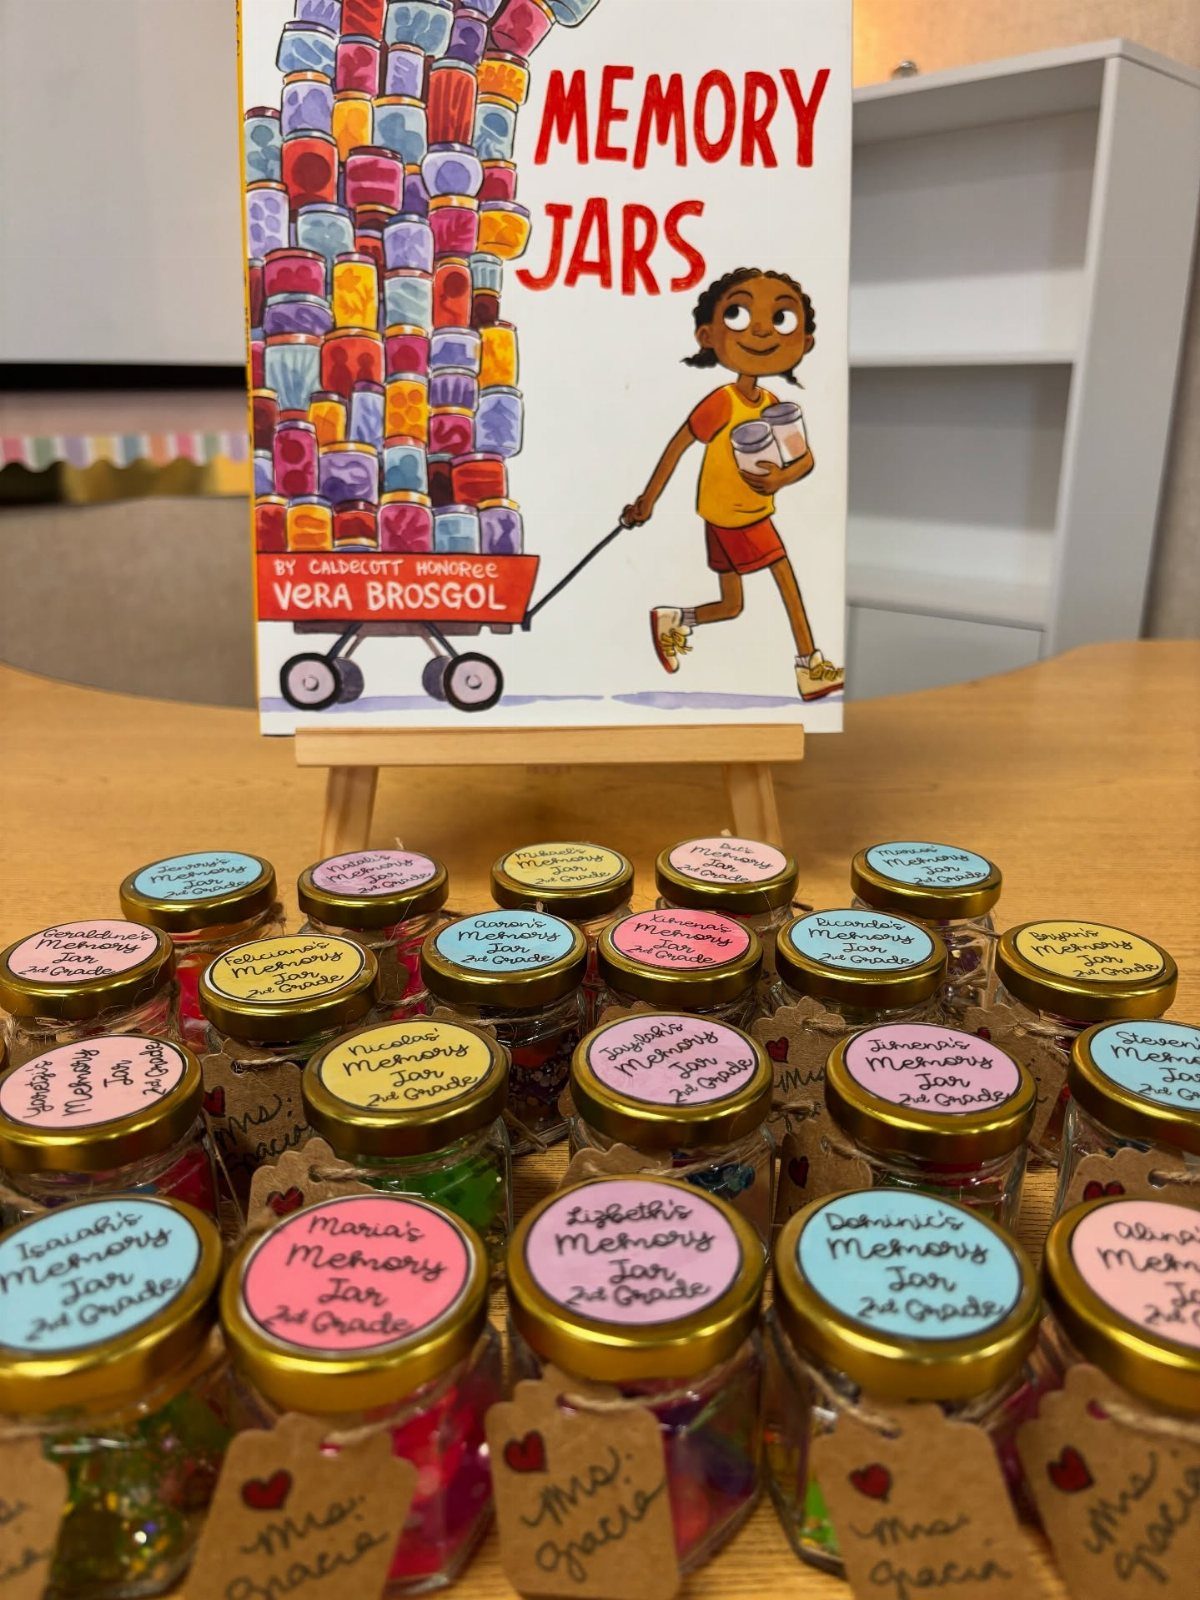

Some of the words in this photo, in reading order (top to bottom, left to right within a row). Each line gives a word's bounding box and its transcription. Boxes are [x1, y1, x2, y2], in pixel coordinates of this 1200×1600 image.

[534, 65, 831, 169] MEMORY
[515, 197, 706, 296] JARS
[273, 559, 296, 577] BY
[366, 581, 507, 611] BROSGOL
[690, 845, 773, 869] Memory
[150, 865, 247, 884] Memory
[44, 928, 153, 941] Geraldine's
[634, 922, 733, 947] Memory
[650, 914, 732, 933] Ximena's
[815, 917, 906, 931] Ricardo's
[1029, 928, 1099, 942] Bryan's
[35, 938, 141, 954] Memory
[458, 931, 561, 942] Memory
[653, 938, 695, 953] Jar
[808, 928, 915, 945] Memory
[842, 942, 887, 953] Jar
[1031, 939, 1133, 957] Memory
[52, 952, 99, 964] Jar
[224, 941, 329, 966] Feliciano's
[487, 943, 530, 954] Jar
[492, 954, 555, 965] Grade
[655, 950, 717, 964] Grade
[850, 955, 915, 965] Grade
[50, 965, 116, 976] Grade
[232, 951, 343, 979] Memory
[1077, 955, 1123, 966] Jar
[1102, 963, 1159, 976] Grade
[273, 970, 320, 985] Jar
[279, 974, 344, 993] Grade
[348, 1028, 440, 1056] Nicolas'
[868, 1037, 970, 1052] Jimena's
[1115, 1031, 1200, 1050] Steven'
[139, 1041, 169, 1077] Grade
[342, 1043, 469, 1076] Memory
[614, 1031, 719, 1078] Memory
[865, 1055, 994, 1072] Memory
[102, 1060, 134, 1088] Jar
[390, 1068, 444, 1088] Jar
[668, 1057, 718, 1079] Jar
[697, 1058, 753, 1089] Grade
[62, 1049, 100, 1117] Memory
[403, 1075, 478, 1100] Grade
[914, 1072, 970, 1090] Jar
[934, 1088, 1012, 1107] Grade
[566, 1199, 693, 1229] Lizbeth's
[824, 1210, 964, 1232] Dominic's
[16, 1211, 143, 1261] Isaiah's
[308, 1215, 425, 1242] Maria's
[555, 1229, 716, 1256] Memory
[827, 1236, 988, 1265] Memory
[0, 1227, 172, 1294] Memory
[285, 1242, 447, 1282] Memory
[608, 1258, 677, 1285] Jar
[61, 1271, 134, 1307] Jar
[885, 1265, 957, 1292] Jar
[78, 1277, 182, 1326] Grade
[317, 1277, 389, 1307] Jar
[613, 1279, 712, 1308] Grade
[905, 1295, 1007, 1322] Grade
[312, 1309, 415, 1336] Grade
